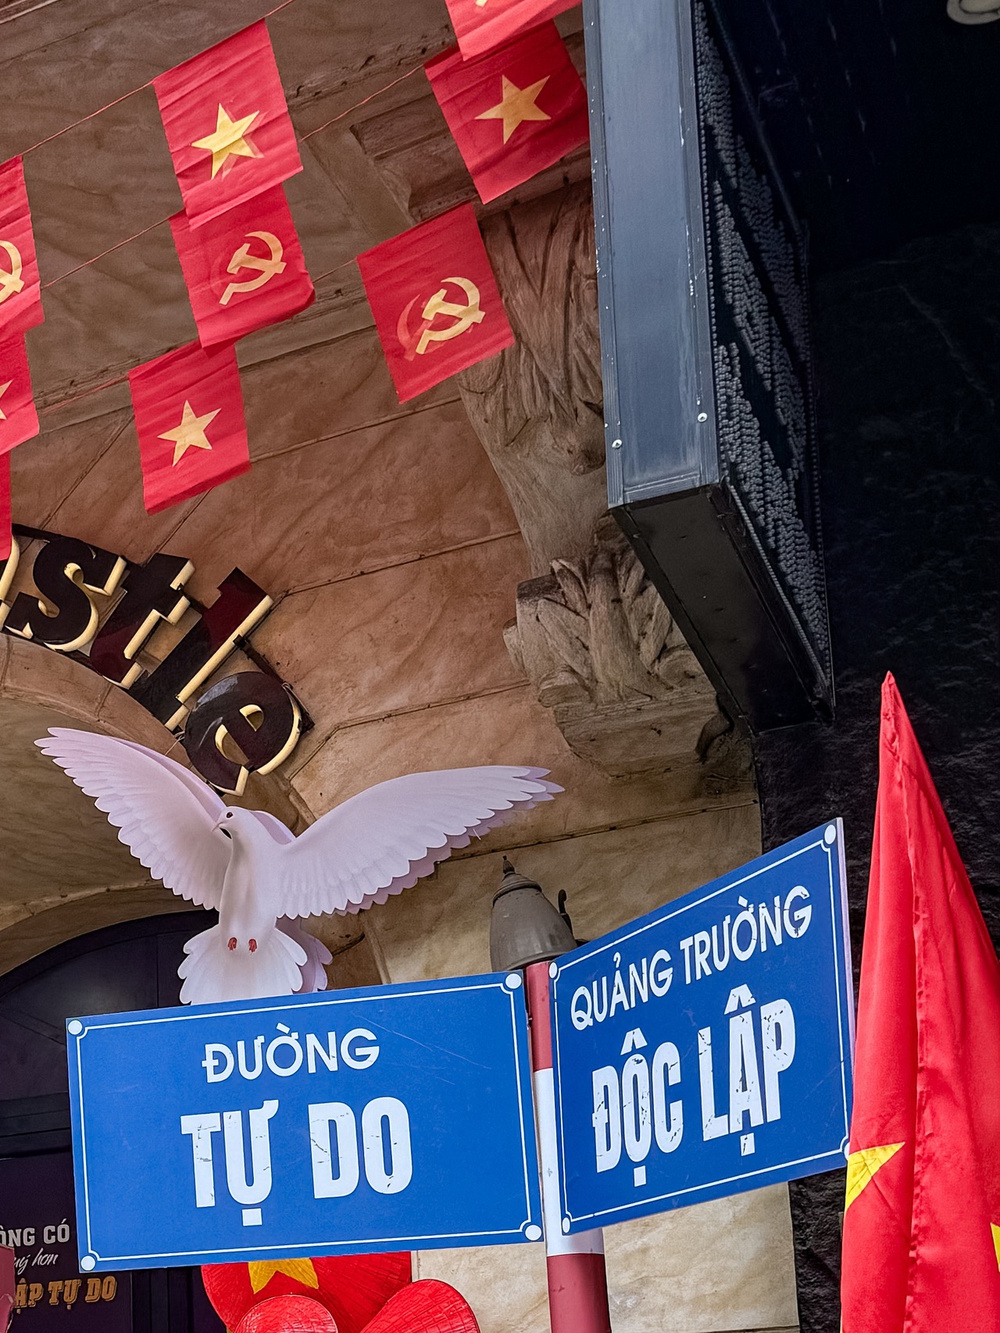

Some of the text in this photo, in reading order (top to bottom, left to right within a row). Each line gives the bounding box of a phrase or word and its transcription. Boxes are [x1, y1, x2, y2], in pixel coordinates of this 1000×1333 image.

[570, 885, 812, 1031] QUẢNG TRƯỜNG
[202, 1022, 380, 1083] ĐƯỜNG
[592, 984, 796, 1187] ĐỘC LẬP
[180, 1097, 413, 1226] TỰ DO
[43, 1218, 70, 1244] CÓ
[14, 1275, 117, 1314] ẬP TỰ DO
